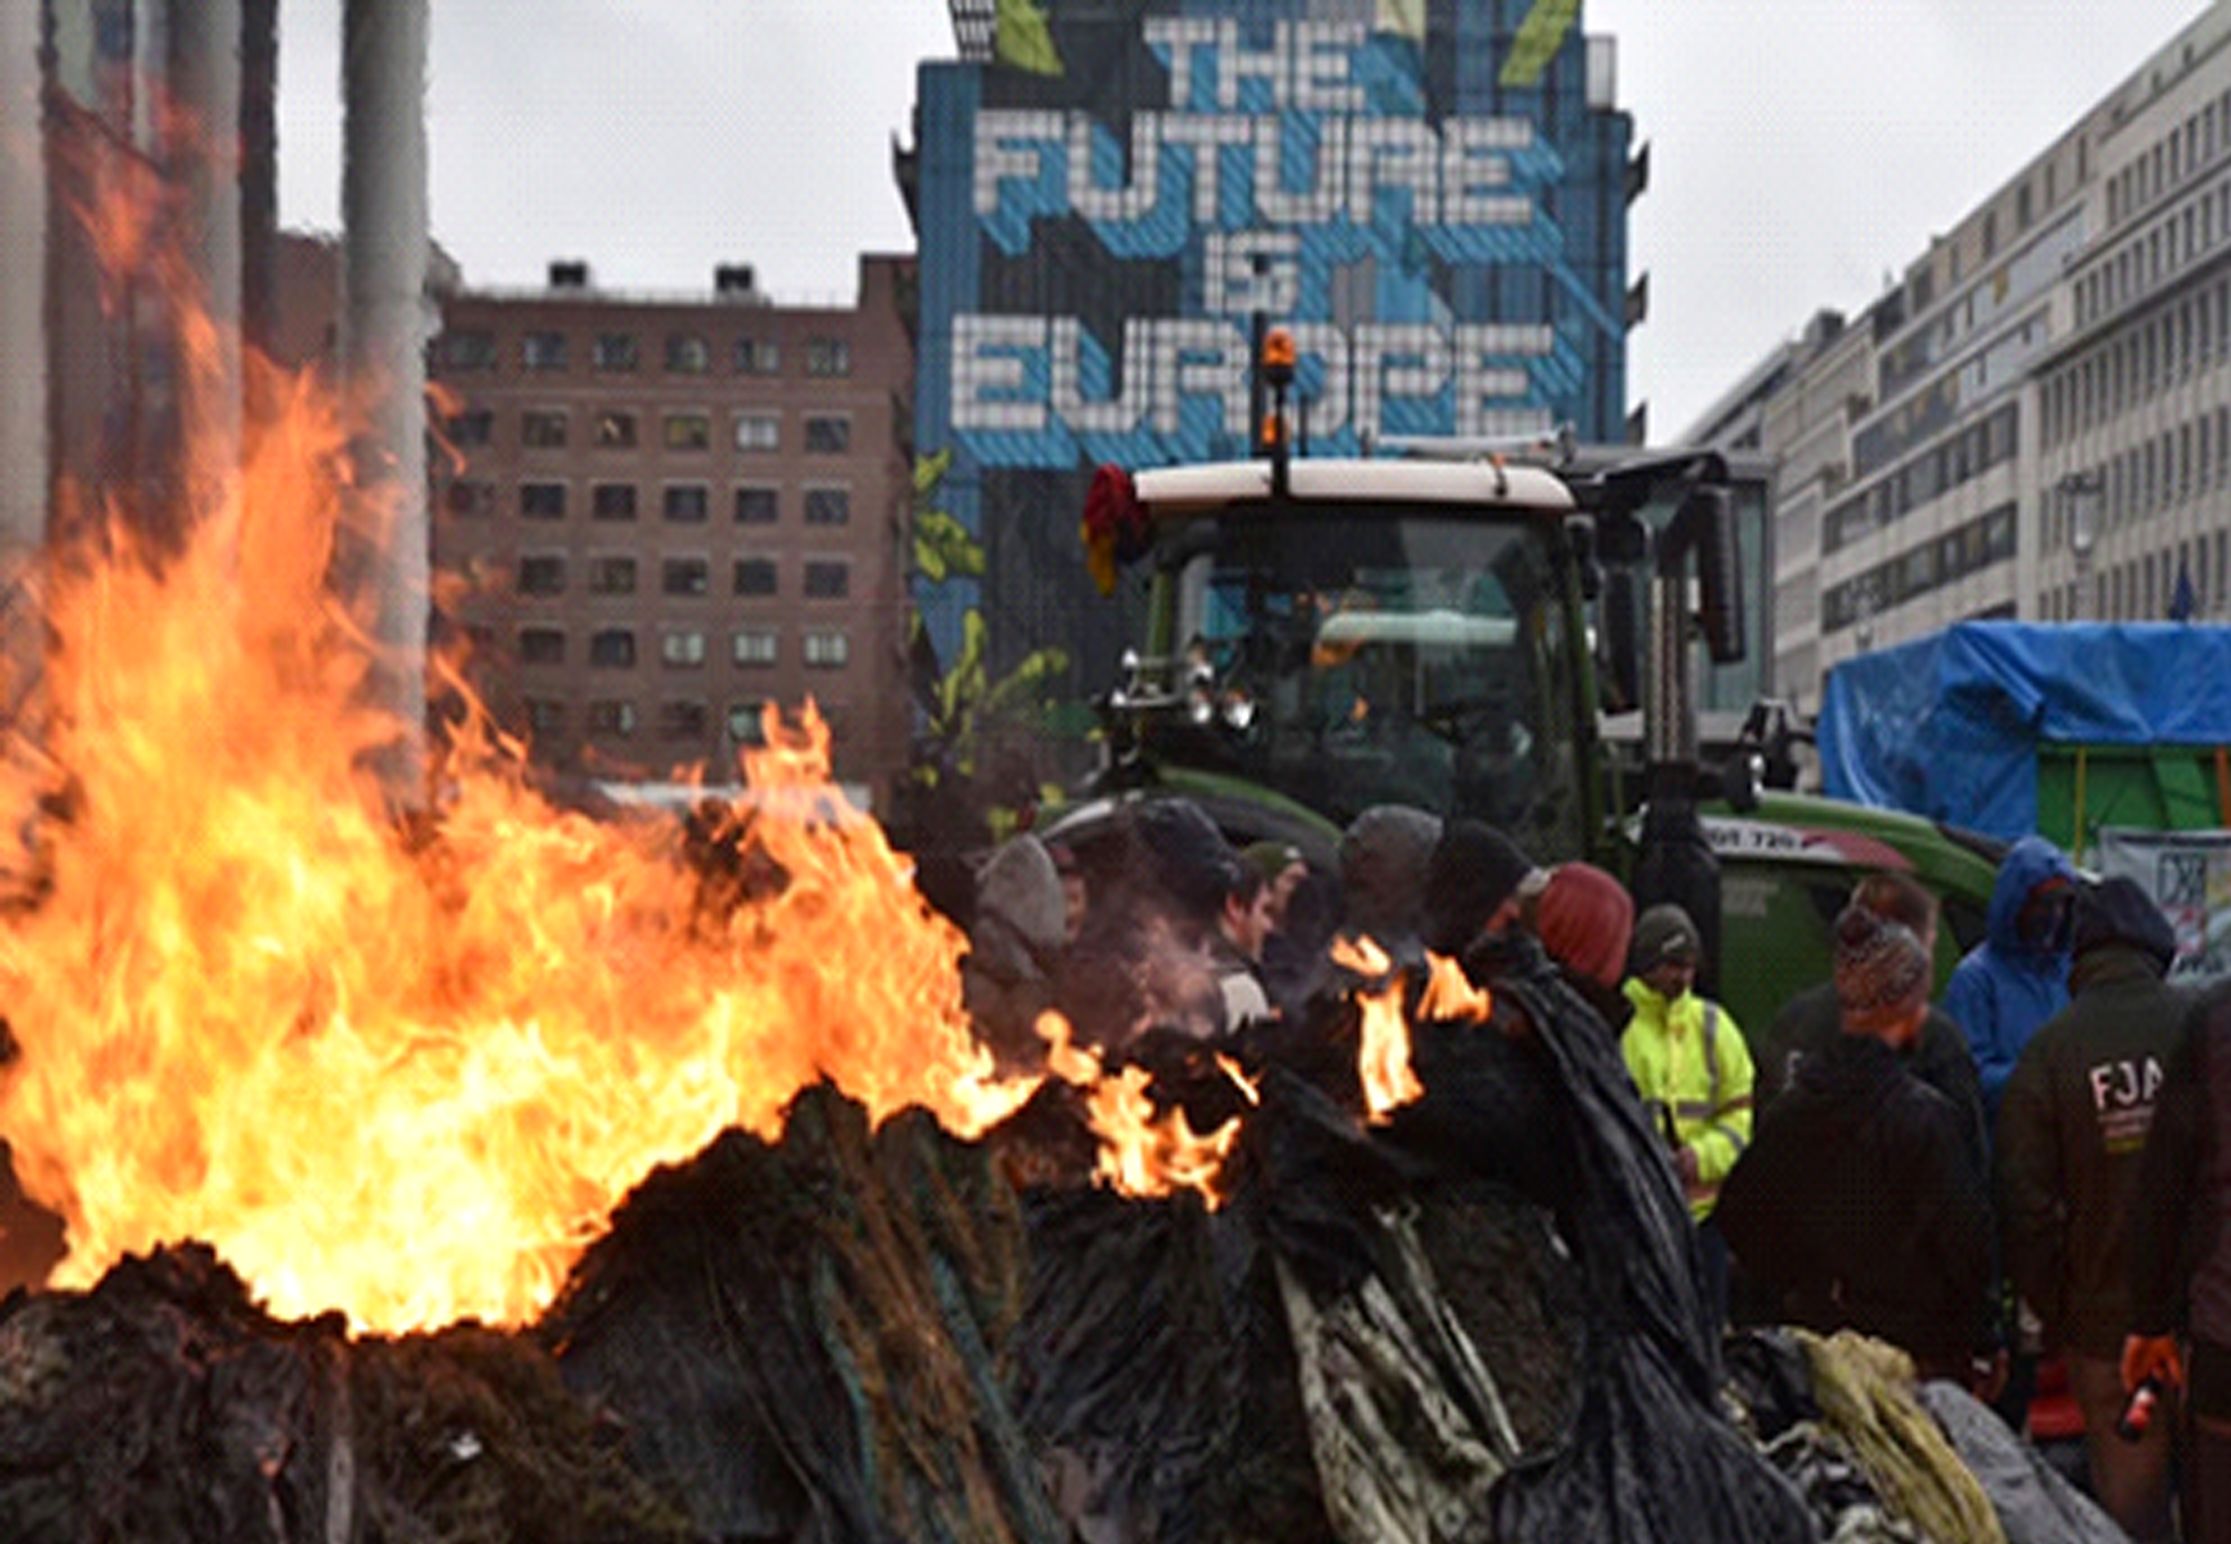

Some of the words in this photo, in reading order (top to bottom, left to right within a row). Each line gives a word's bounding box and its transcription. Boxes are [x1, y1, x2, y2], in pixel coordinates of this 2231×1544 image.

[1144, 18, 1366, 108] THE
[973, 110, 1532, 224] FUTURE
[1204, 232, 1299, 313] IS
[951, 315, 1554, 437] EUROPE
[2088, 1056, 2165, 1111] FJA
